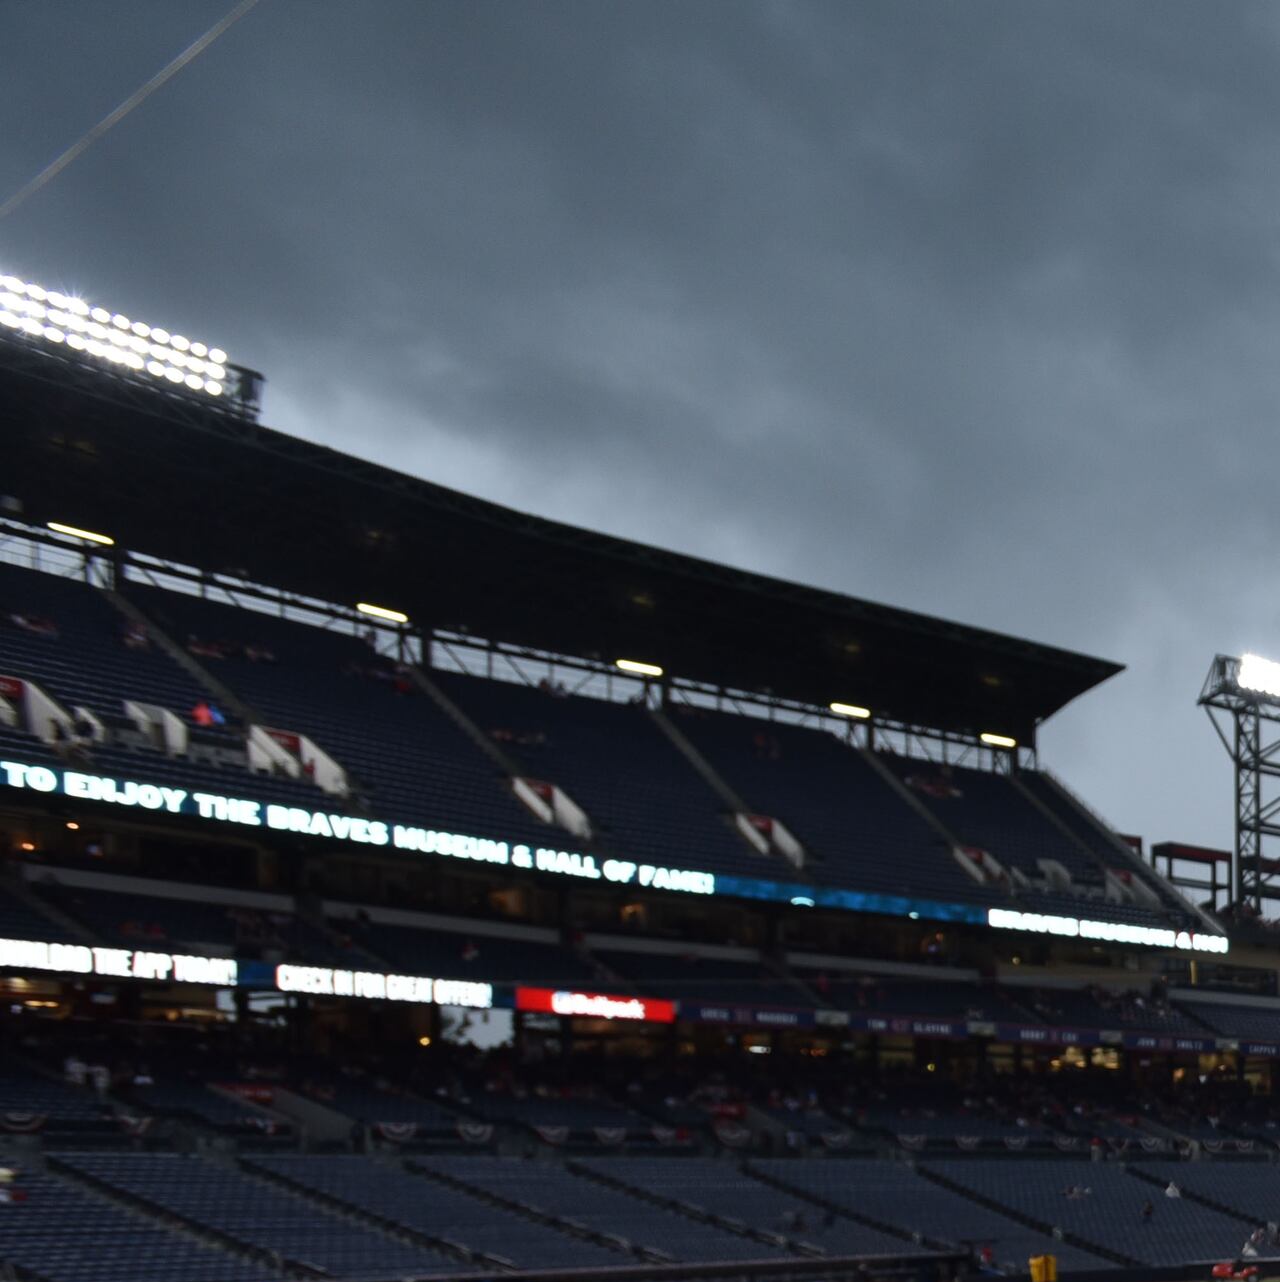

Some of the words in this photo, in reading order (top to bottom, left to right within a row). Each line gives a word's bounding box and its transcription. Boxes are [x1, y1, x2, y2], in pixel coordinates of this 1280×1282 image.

[1, 761, 57, 792] TO
[63, 771, 187, 813] ENJOY
[193, 792, 261, 826] THE
[266, 805, 389, 845] BRAVES
[393, 825, 509, 864] MUSEUM
[511, 845, 533, 868] &
[536, 848, 601, 879] HALL
[603, 859, 637, 884] OF
[92, 947, 133, 977] THE
[132, 951, 173, 979] APP
